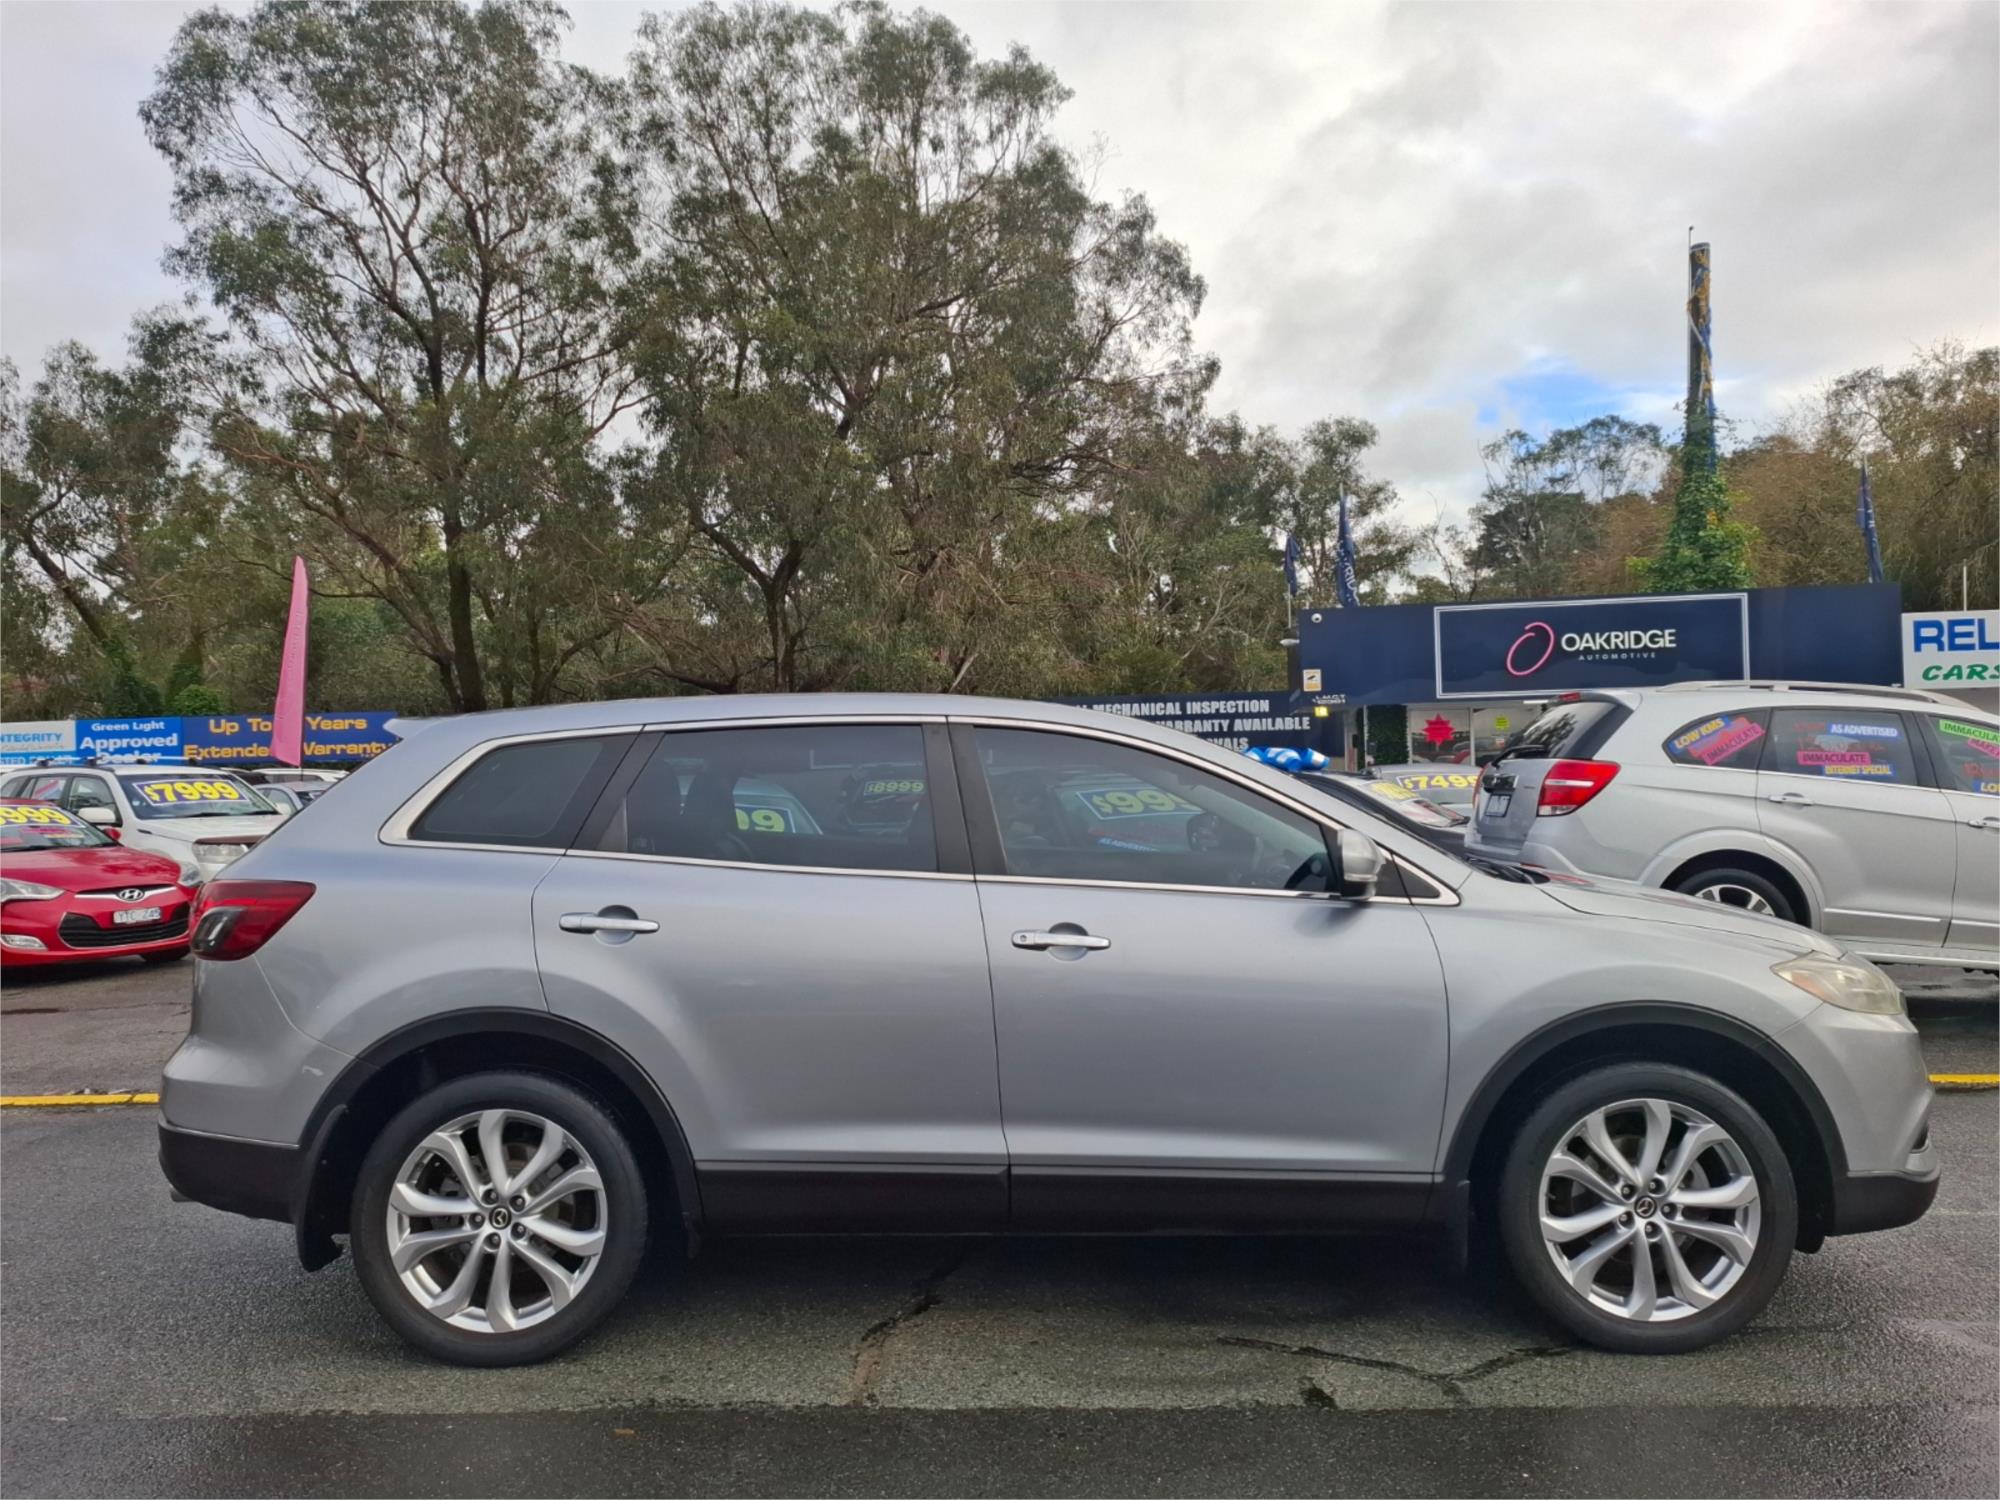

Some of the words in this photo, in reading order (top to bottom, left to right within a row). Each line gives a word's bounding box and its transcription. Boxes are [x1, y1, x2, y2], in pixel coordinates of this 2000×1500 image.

[1561, 629, 1677, 651] OAKRIDGE
[1914, 618, 2000, 652] REL
[1579, 652, 1656, 661] AUTOMOTIVE
[1186, 700, 1269, 715] INSPECTION
[91, 722, 129, 731] Green
[133, 721, 165, 732] Light
[209, 719, 240, 735] Up
[248, 718, 272, 732] To
[305, 716, 368, 730] Years
[1154, 718, 1229, 733] ARRANTY
[1234, 717, 1311, 731] AVAILABLE
[1830, 723, 1842, 734] AS
[1844, 724, 1898, 737] ADVERTISED
[80, 733, 179, 751] Approved
[1673, 729, 1700, 748] LOW
[184, 744, 271, 760] Extende
[1803, 754, 1866, 763] IMMACULATE
[144, 782, 241, 802] $7999
[0, 806, 72, 825] 999
